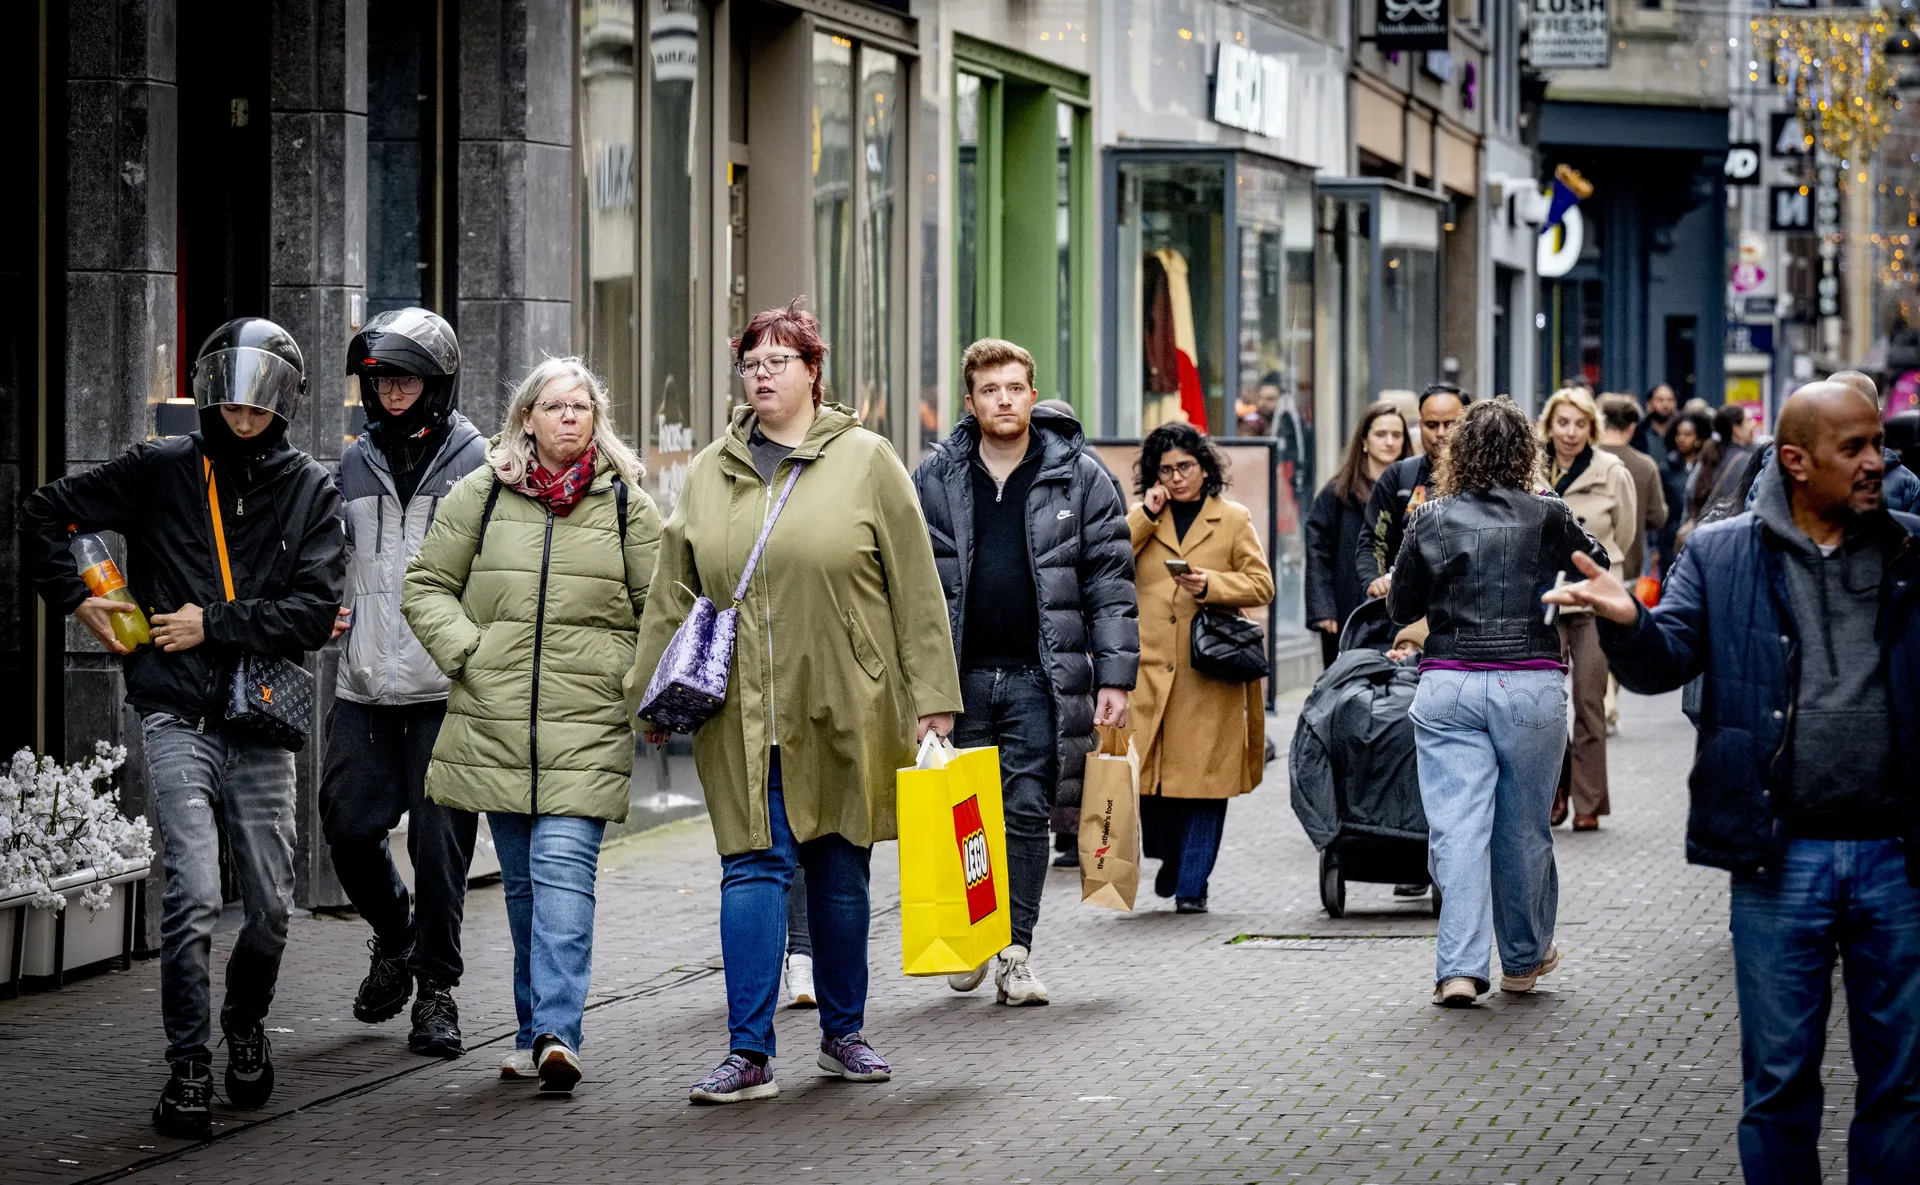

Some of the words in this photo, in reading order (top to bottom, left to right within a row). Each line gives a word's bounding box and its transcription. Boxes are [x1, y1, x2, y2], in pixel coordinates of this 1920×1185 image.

[1533, 0, 1604, 13] LUSH
[1105, 799, 1114, 815] foot
[1101, 815, 1112, 846] athlete's
[963, 831, 988, 886] LEGO
[1097, 857, 1105, 870] the
